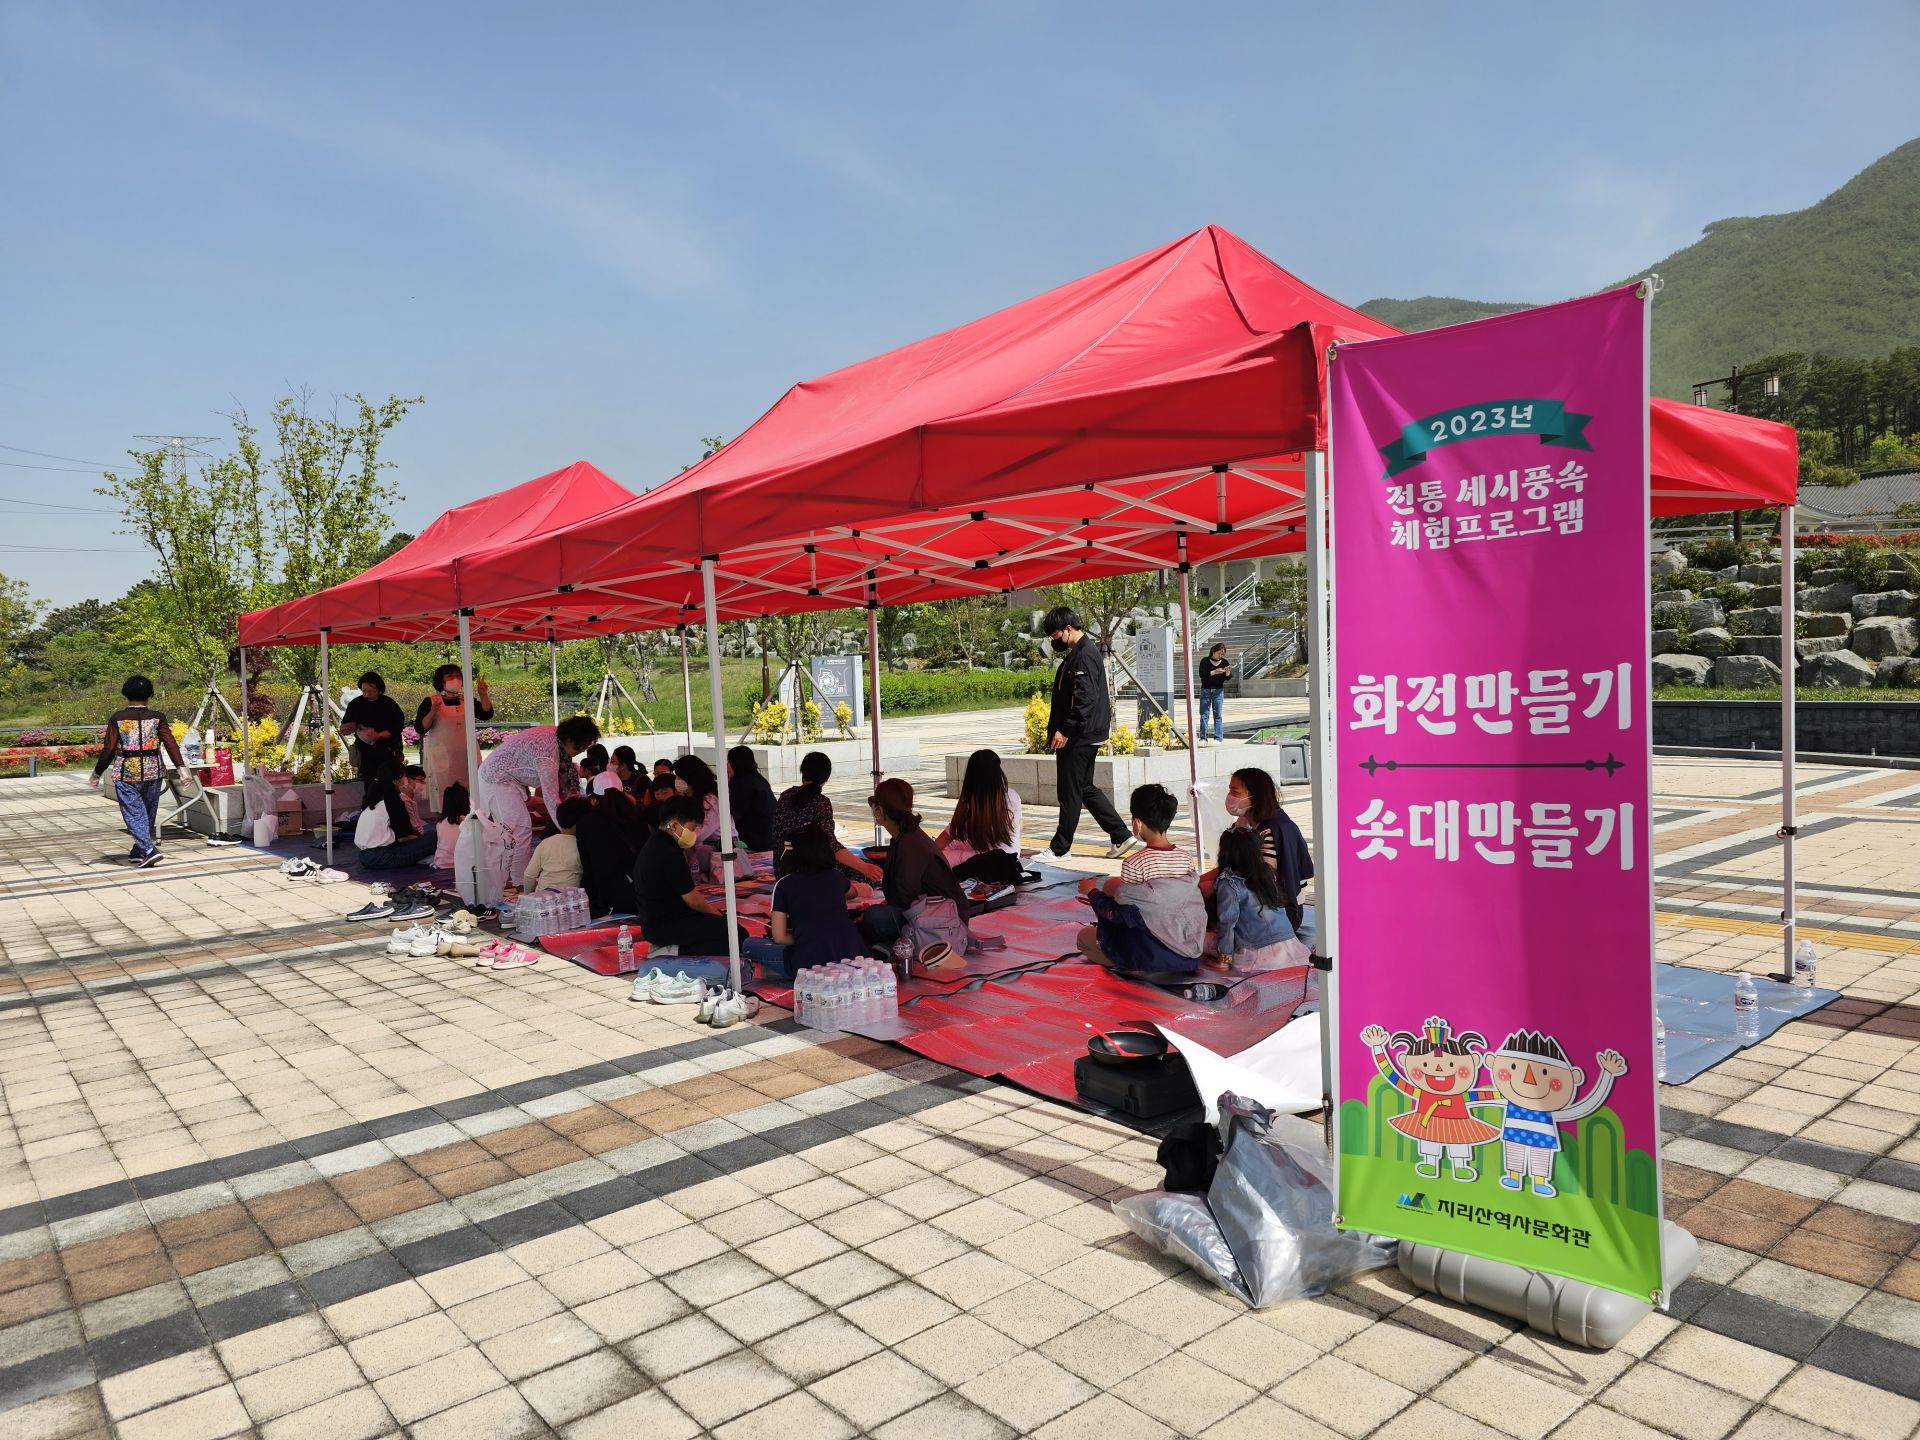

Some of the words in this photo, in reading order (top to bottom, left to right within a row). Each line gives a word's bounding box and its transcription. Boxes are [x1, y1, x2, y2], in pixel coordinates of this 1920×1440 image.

[1431, 404, 1534, 442] 2023년
[1385, 480, 1447, 516] 전통
[1456, 460, 1588, 507] 세시풍속
[1389, 498, 1584, 551] 체험프로그램
[1349, 662, 1632, 736] 화전만들기
[1350, 798, 1634, 870] 솟대만들기
[1437, 1199, 1592, 1249] 지리산역사문화관
